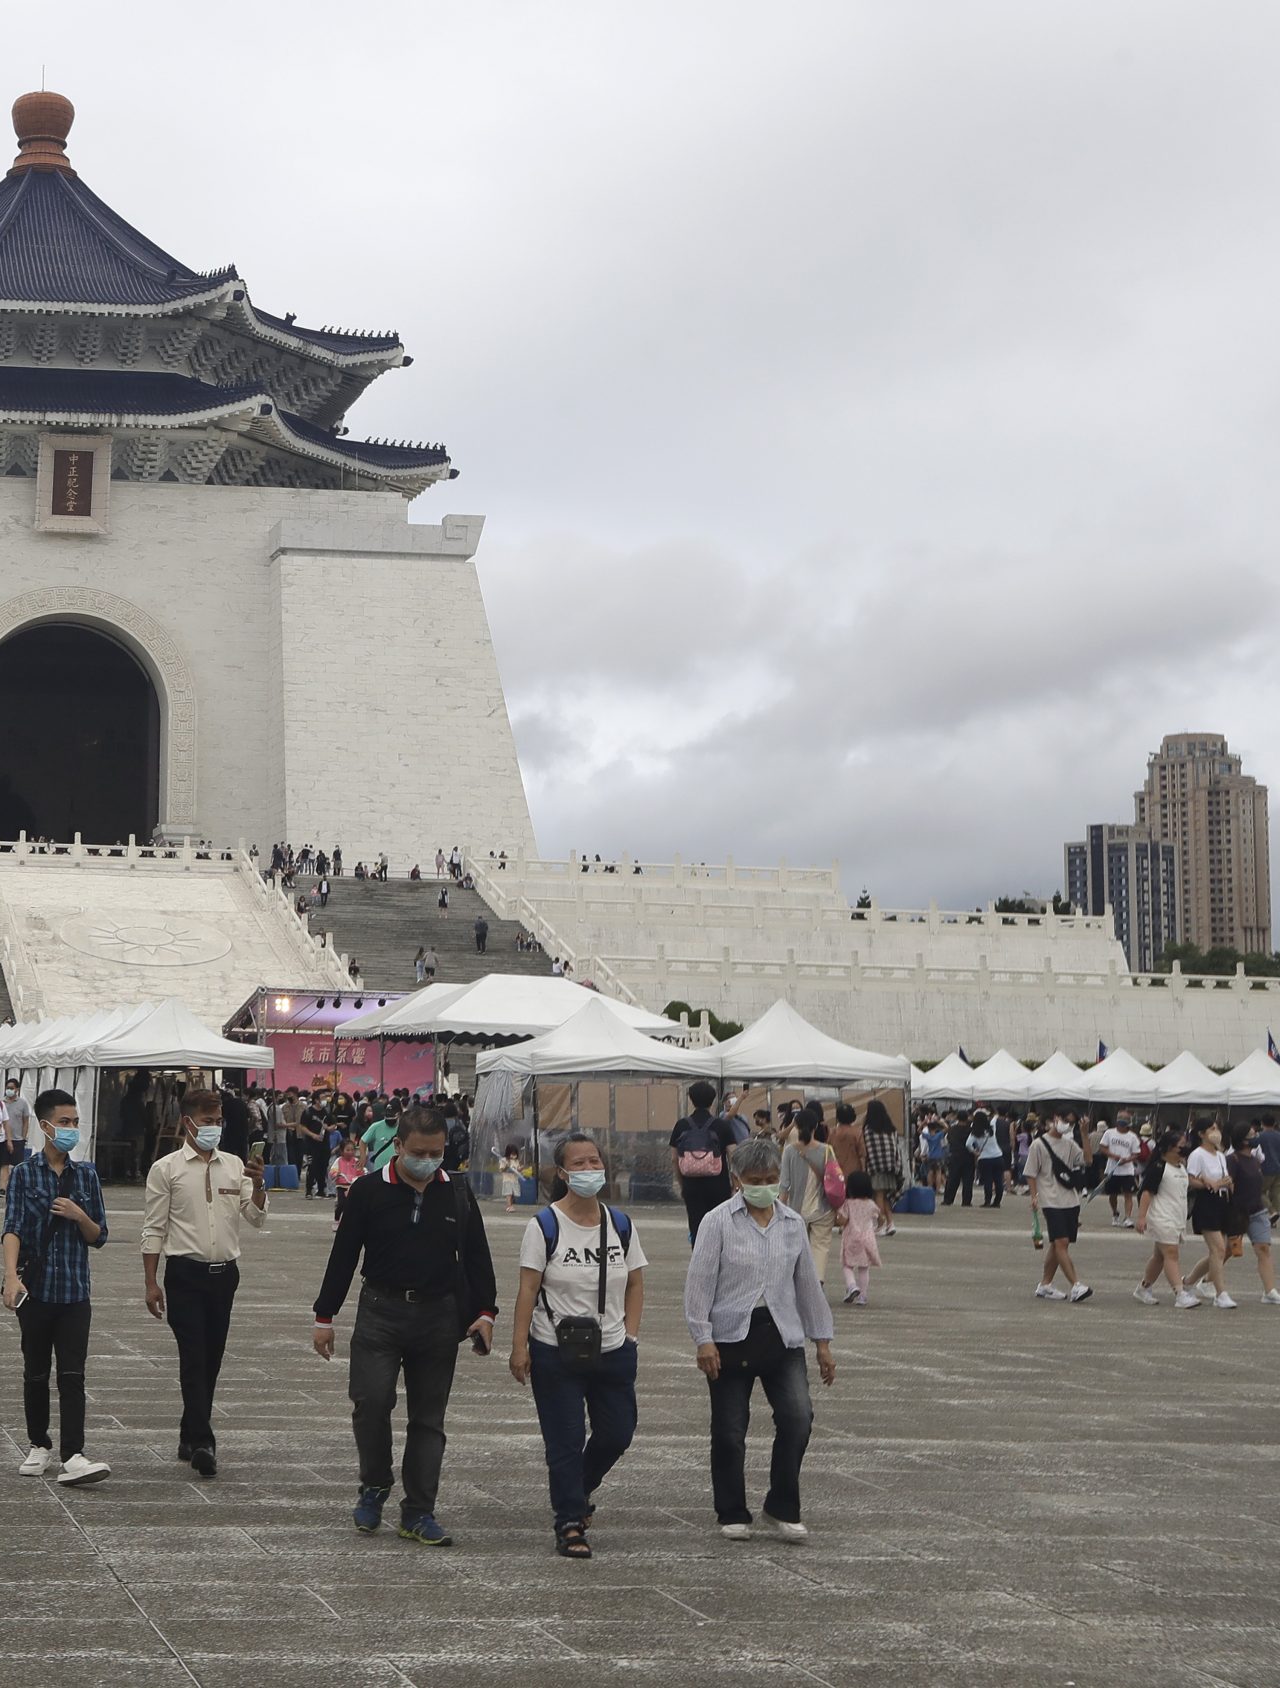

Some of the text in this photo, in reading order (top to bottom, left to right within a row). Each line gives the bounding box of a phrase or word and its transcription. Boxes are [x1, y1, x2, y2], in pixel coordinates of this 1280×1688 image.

[66, 453, 79, 511] 中正紀念堂
